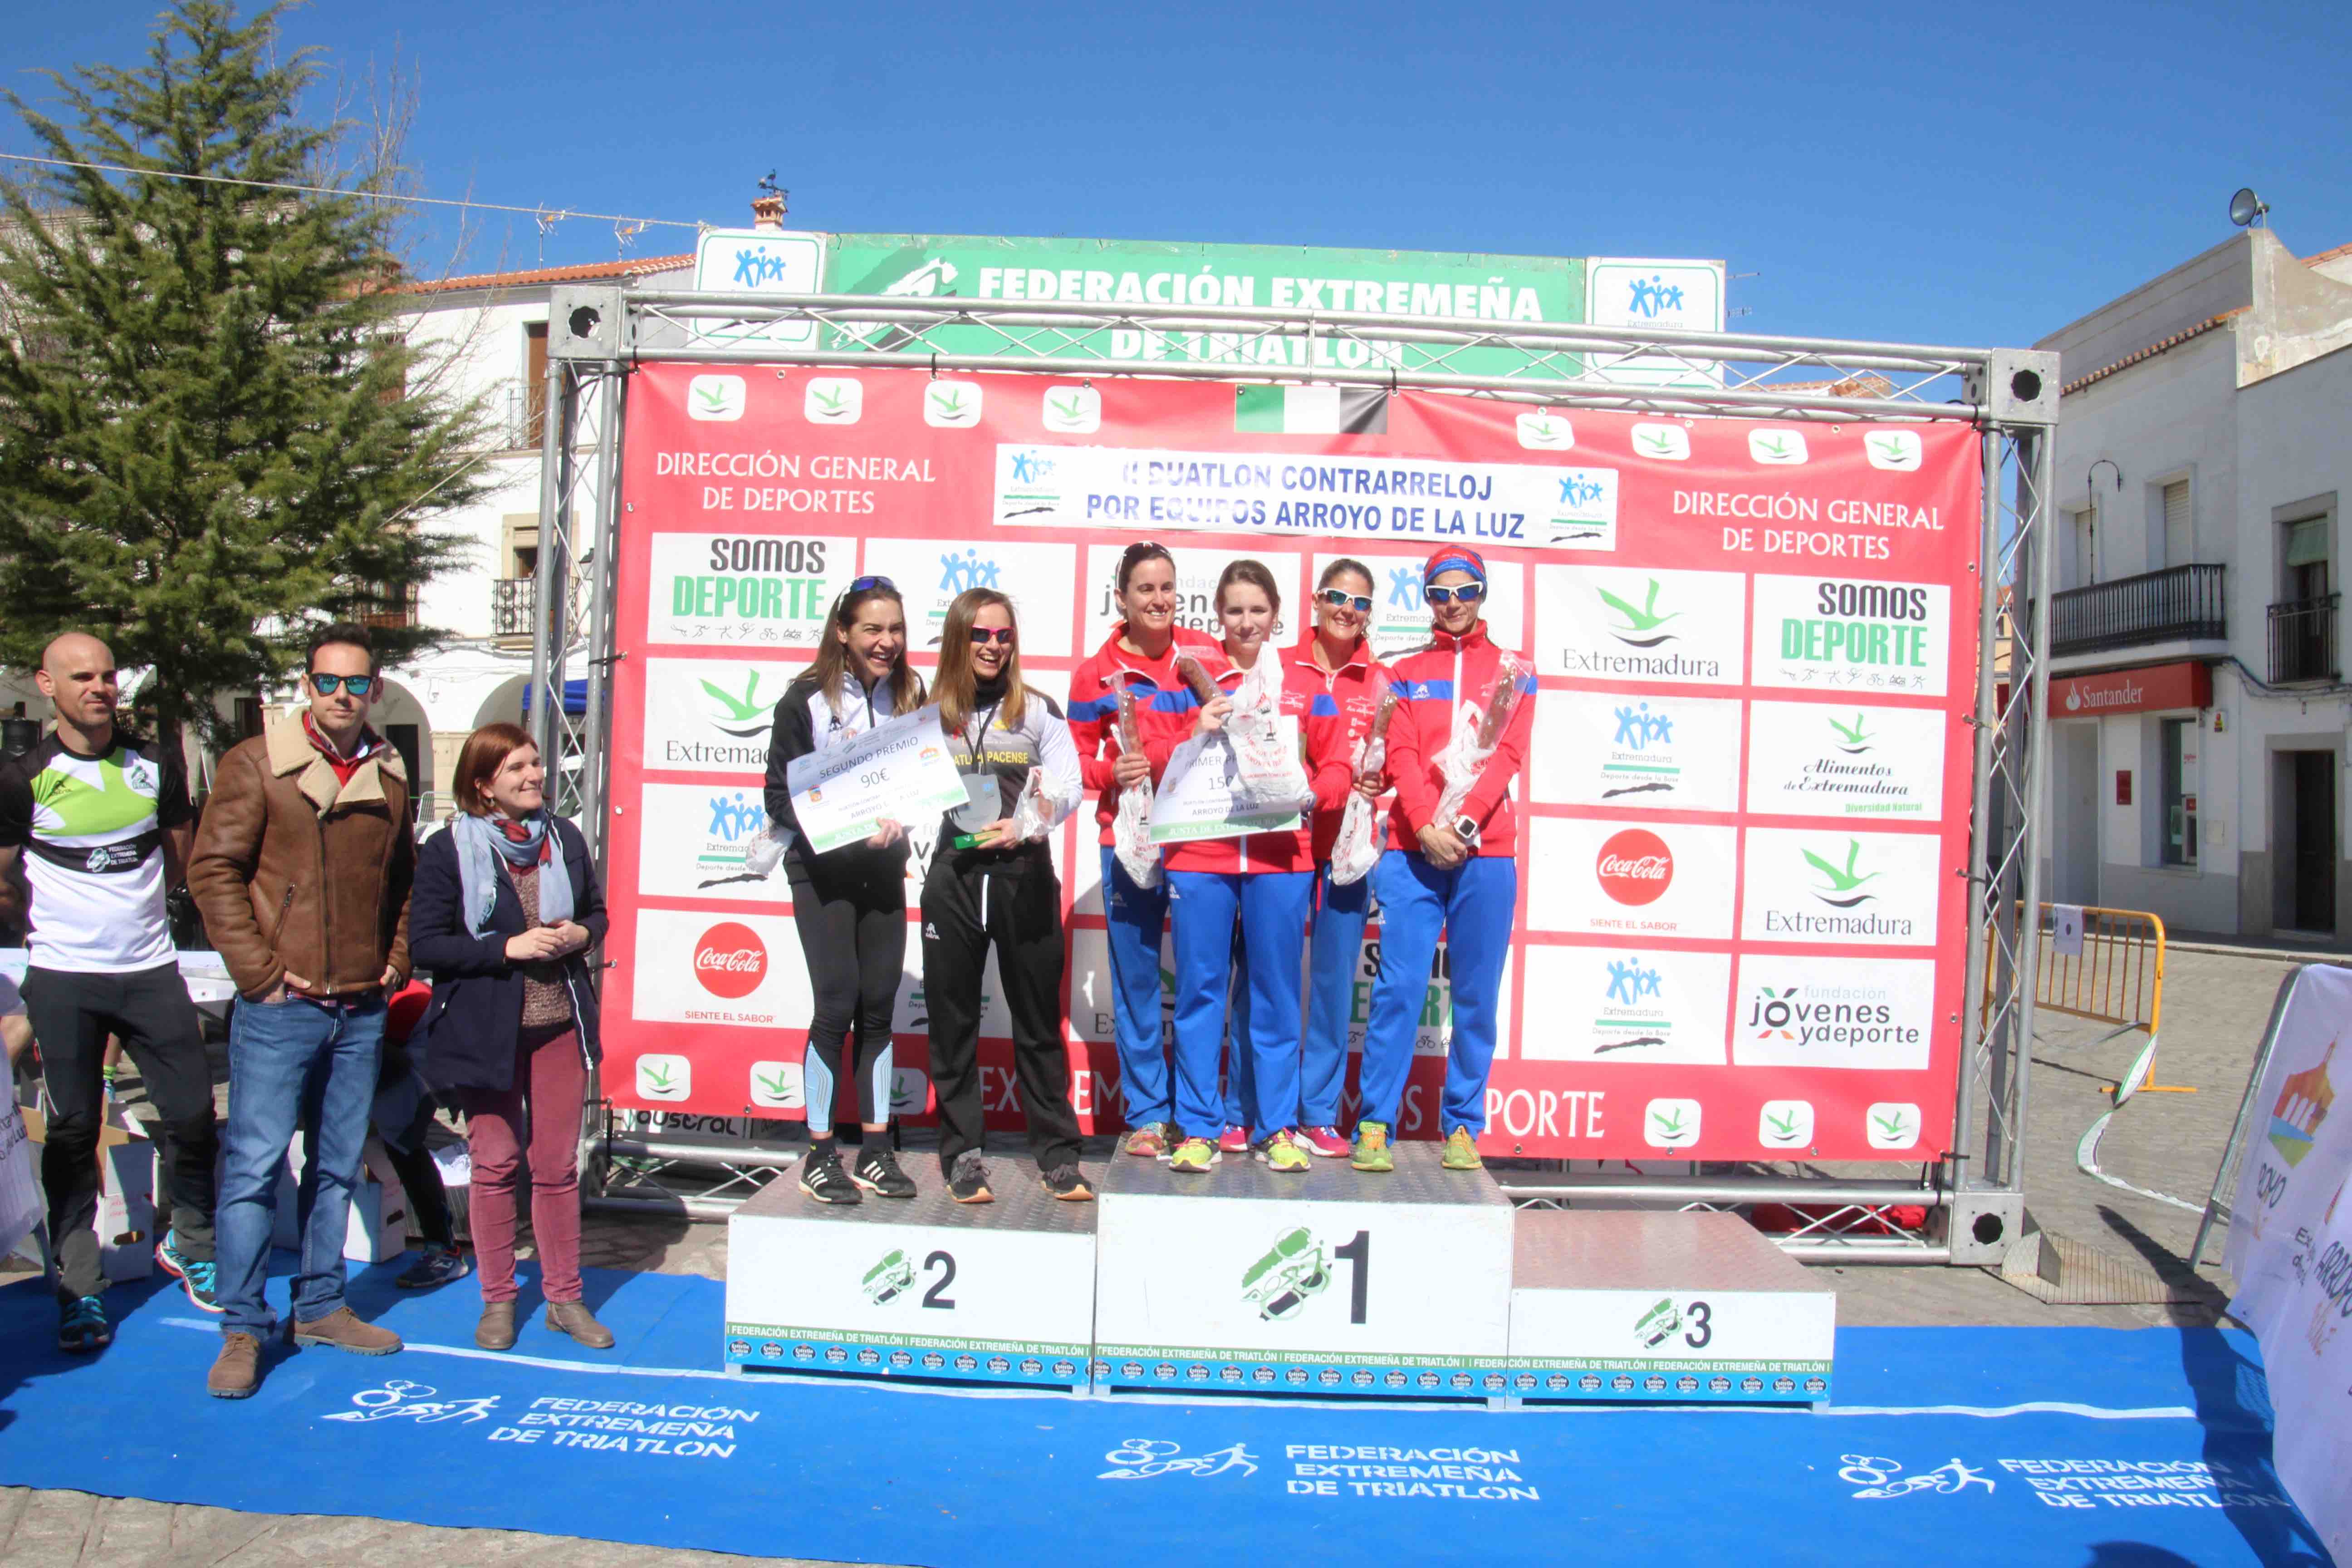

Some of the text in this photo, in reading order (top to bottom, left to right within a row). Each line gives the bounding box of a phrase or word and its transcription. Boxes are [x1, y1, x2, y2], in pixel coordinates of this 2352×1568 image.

[979, 265, 1543, 321] FEDERACIÓN EXTREMEÑA
[1111, 328, 1172, 360] DE
[657, 450, 936, 482] DIRECCIÓN GENERAL
[1281, 466, 1492, 501] CONTRARRELOJ
[703, 487, 874, 514] DE DEPORTES
[1673, 490, 1944, 530] DIRECCIÓN GENERAL
[1086, 493, 1525, 539] POR EQUIPOS ARROYO DE LA LUZ
[1723, 527, 1890, 560] DE DEPORTES
[710, 538, 826, 573] SOMOS
[672, 575, 826, 621] DEPORTE
[1818, 582, 1927, 621] SOMOS
[1781, 618, 1927, 667] DEPORTE
[1563, 648, 1719, 676] Extremadura
[2083, 684, 2143, 708] Santander
[666, 740, 770, 764] Extrema
[819, 752, 873, 779] SEGUNDO
[876, 736, 919, 758] PREMIO
[987, 751, 1029, 764] PACENSE
[1612, 751, 1672, 764] Extremadura
[861, 768, 891, 788] 90€
[1600, 772, 1629, 782] Deporte
[1632, 773, 1653, 782] desde
[1803, 758, 1894, 777] Alimentos
[1784, 776, 1909, 796] de Extremadura
[1192, 806, 1224, 817] ARROYO
[1845, 802, 1922, 813] Diversidad Natural
[1590, 918, 1677, 931] SIENTE EL SABOR
[1765, 910, 1912, 937] Extremadura
[1803, 984, 1886, 1000] fundación
[685, 1010, 774, 1024] SIENTE EL SABOR
[1603, 1007, 1664, 1018] Extremadura
[1592, 1027, 1621, 1037] Deporte
[1623, 1028, 1644, 1036] desde
[1655, 1029, 1671, 1037] Base
[1483, 1088, 1606, 1138] PORTE
[922, 1250, 957, 1310] 2
[1335, 1230, 1370, 1324] 1
[732, 1325, 904, 1345] FEDERACIÓN EXTREMEÑA DE TRIATLÓN
[1685, 1301, 1712, 1348] 3
[910, 1338, 1084, 1356] FEDERACIÓN EXTREMEÑA DE TRIATLÓN
[1102, 1346, 1278, 1362] FEDERACIÓN EXTREMEÑA DE TRIATLÓN
[1284, 1352, 1460, 1367] FEDERACIÓN EXTREMEÑA DE TRIATLÓN
[1474, 1357, 1646, 1370] FEDERACIÓN EXTREMEÑA DE TRIATLÓN
[1653, 1359, 1825, 1372] FEDERACIÓN EXTREMEÑA DE TRIATLÓN
[529, 1396, 761, 1423] FEDERACIÓN
[487, 1426, 547, 1443] DE
[517, 1412, 735, 1440] EXTREMEÑA
[1285, 1444, 1521, 1464] FEDERACIÓN
[1294, 1462, 1523, 1483] EXTREMEÑA
[1287, 1480, 1339, 1496] DE
[2035, 1491, 2096, 1508] DE
